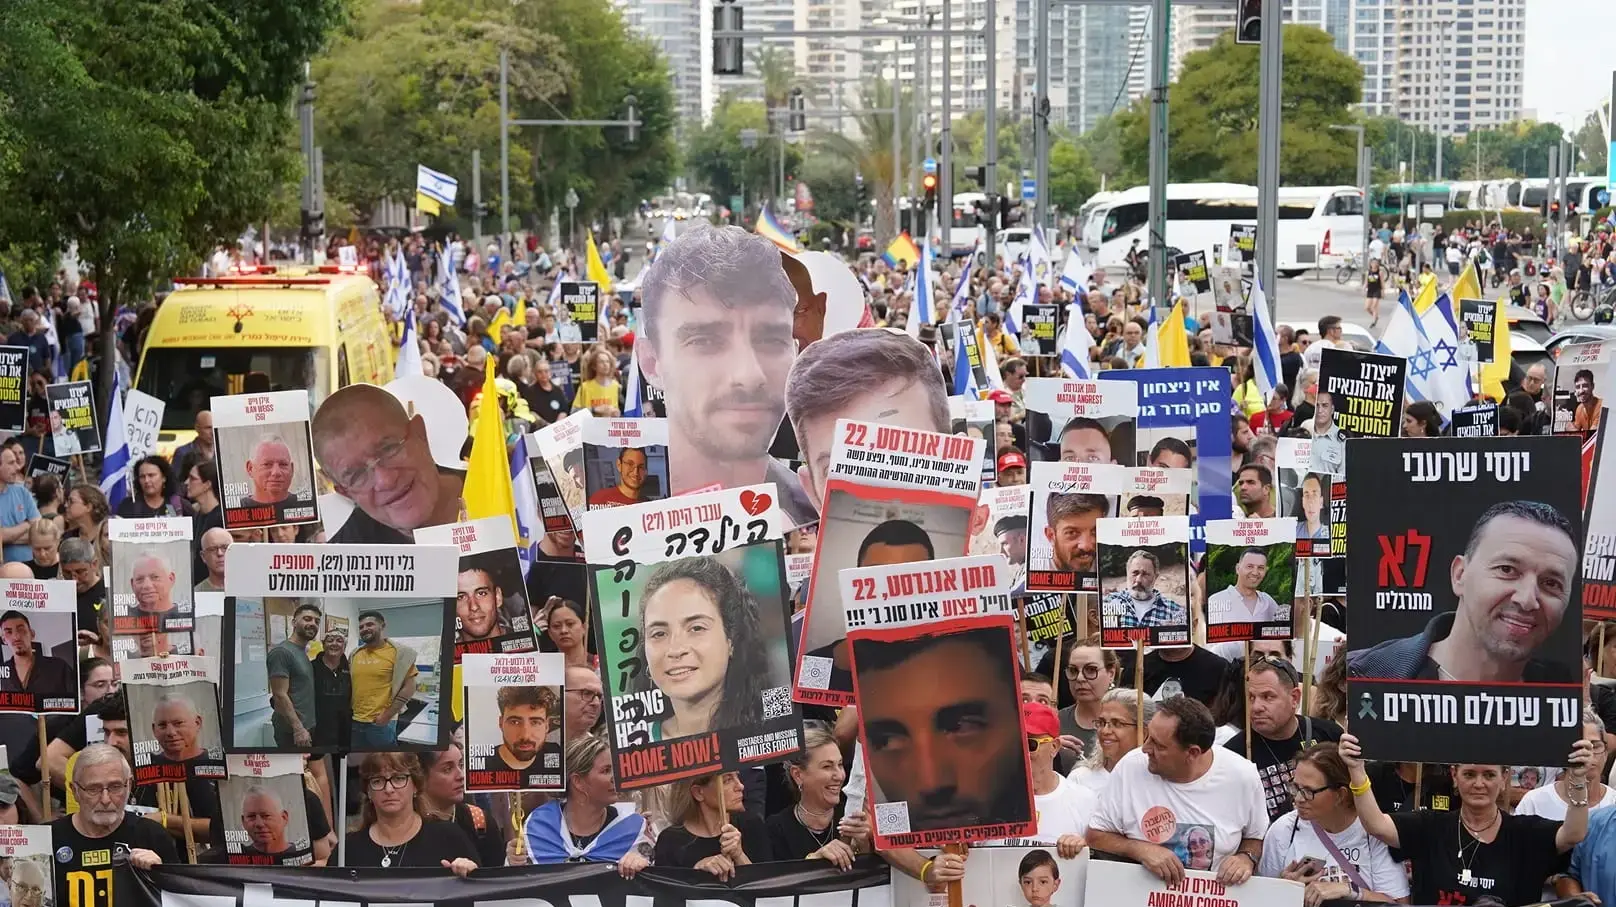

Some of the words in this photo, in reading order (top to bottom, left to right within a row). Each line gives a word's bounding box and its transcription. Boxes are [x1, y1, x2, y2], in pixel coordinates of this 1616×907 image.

[1144, 382, 1190, 398] ניצחון
[1196, 380, 1220, 396] אין
[1328, 376, 1374, 398] התנאים
[1376, 384, 1395, 400] את
[1056, 394, 1076, 402] MATAN
[1078, 394, 1102, 404] ANGREST
[1346, 396, 1394, 418] לשחרור
[134, 404, 158, 428] הוא
[258, 404, 274, 412] WEISS
[1160, 403, 1190, 416] הדר
[1196, 402, 1221, 418] סגן
[844, 422, 868, 446] 22
[1457, 425, 1482, 438] התנאים
[1483, 424, 1494, 436] את
[846, 448, 866, 462] קשה
[942, 436, 974, 462] מתן
[866, 452, 885, 464] נפצע
[955, 464, 969, 475] יצא
[1402, 452, 1478, 482] שרעבי
[1484, 452, 1530, 482] יוסי
[878, 468, 914, 483] מהרשימה
[914, 473, 940, 486] המדינה
[1063, 474, 1077, 482] DAVID
[1078, 474, 1092, 482] CUNIO
[224, 482, 248, 496] BRING
[955, 480, 976, 492] והוצא
[225, 496, 242, 509] HIM
[226, 509, 250, 523] HOME
[251, 506, 276, 521] NOW!
[668, 507, 692, 530] הימן
[695, 503, 722, 524] ענבר
[642, 514, 664, 534] (27)
[665, 516, 768, 557] הילדה
[1138, 536, 1149, 544] (75)
[269, 554, 314, 570] חטופים.
[317, 554, 343, 572] (27),
[346, 554, 371, 572] ברמן
[376, 555, 394, 571] וזיו
[399, 554, 414, 571] גלי
[1376, 528, 1432, 588] לא
[1582, 557, 1616, 581] HIM
[268, 573, 318, 592] המוחלט
[322, 574, 370, 594] הניצחון
[374, 574, 414, 592] תמונת
[960, 564, 996, 592] מתן
[1029, 572, 1050, 586] HOME
[1052, 572, 1076, 586] NOW!
[852, 578, 877, 601] 22
[113, 593, 136, 605] BRING
[942, 597, 978, 617] פצוע
[979, 594, 1009, 613] חייל
[1376, 590, 1432, 611] מתרגלים
[113, 606, 129, 617] HIM
[884, 604, 907, 623] סוג
[910, 601, 940, 620] אינו
[1102, 602, 1127, 616] BRING
[1103, 616, 1118, 628] HIM
[1104, 629, 1128, 641] HOME
[1208, 624, 1229, 638] HOME
[1231, 623, 1253, 636] NOW!
[502, 666, 539, 674] GILBOA-DALAL
[12, 692, 34, 707] NOW!
[1384, 692, 1458, 724] חוזרים
[1464, 692, 1540, 727] שכולם
[1546, 697, 1578, 728] עד
[737, 735, 764, 748] HOSTAGES
[764, 732, 774, 742] AND
[775, 728, 798, 740] MISSING
[133, 740, 160, 754] BRING
[469, 744, 495, 756] BRING
[619, 745, 668, 778] HOME
[671, 732, 721, 768] NOW!
[738, 742, 772, 760] FAMILIES
[772, 737, 799, 752] FORUM
[134, 753, 151, 767] HIM
[469, 757, 486, 770] HIM
[136, 766, 160, 779] HOME
[162, 762, 186, 778] NOW!
[469, 771, 494, 784] HOME
[496, 770, 520, 784] NOW!
[1144, 812, 1172, 827] הושבה
[224, 830, 248, 842] BRING
[924, 830, 962, 842] פצועים
[226, 842, 242, 854] HIM
[1480, 878, 1495, 890] יוסי
[1148, 892, 1194, 907] AMIRAM
